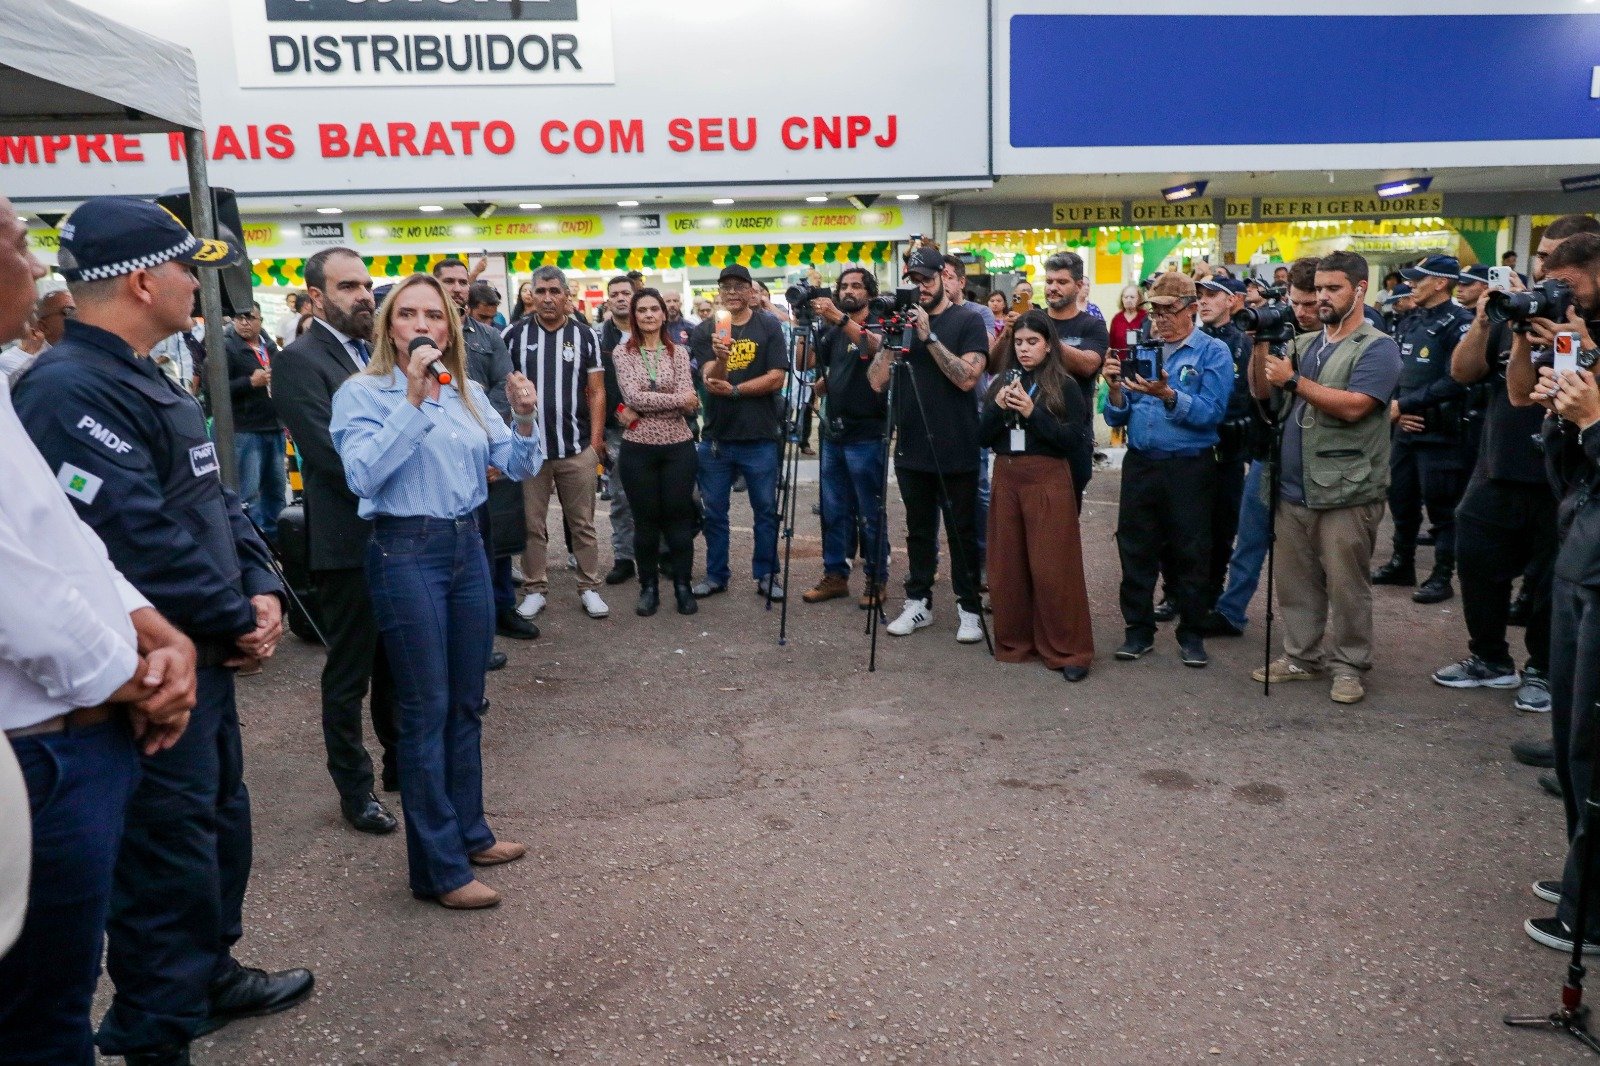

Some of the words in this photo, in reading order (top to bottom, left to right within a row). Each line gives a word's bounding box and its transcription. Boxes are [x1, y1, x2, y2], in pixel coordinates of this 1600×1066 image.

[269, 34, 582, 73] DISTRIBUIDOR
[0, 133, 144, 164] MPRE
[319, 120, 515, 158] BARATO
[540, 119, 644, 155] COM
[668, 117, 757, 153] SEU
[782, 115, 898, 151] CNPJ
[674, 218, 716, 230] VEN
[735, 217, 773, 228] VAREJO
[811, 214, 856, 226] ATACADO
[1055, 207, 1121, 221] SUPER
[1133, 203, 1213, 219] OFERTA
[1227, 203, 1251, 216] DE
[1262, 198, 1441, 216] REFRIGERADORES
[407, 226, 422, 237] NO
[425, 224, 462, 237] VARE
[495, 224, 502, 235] E
[506, 221, 552, 234] ATAC
[77, 415, 132, 453] PMDF
